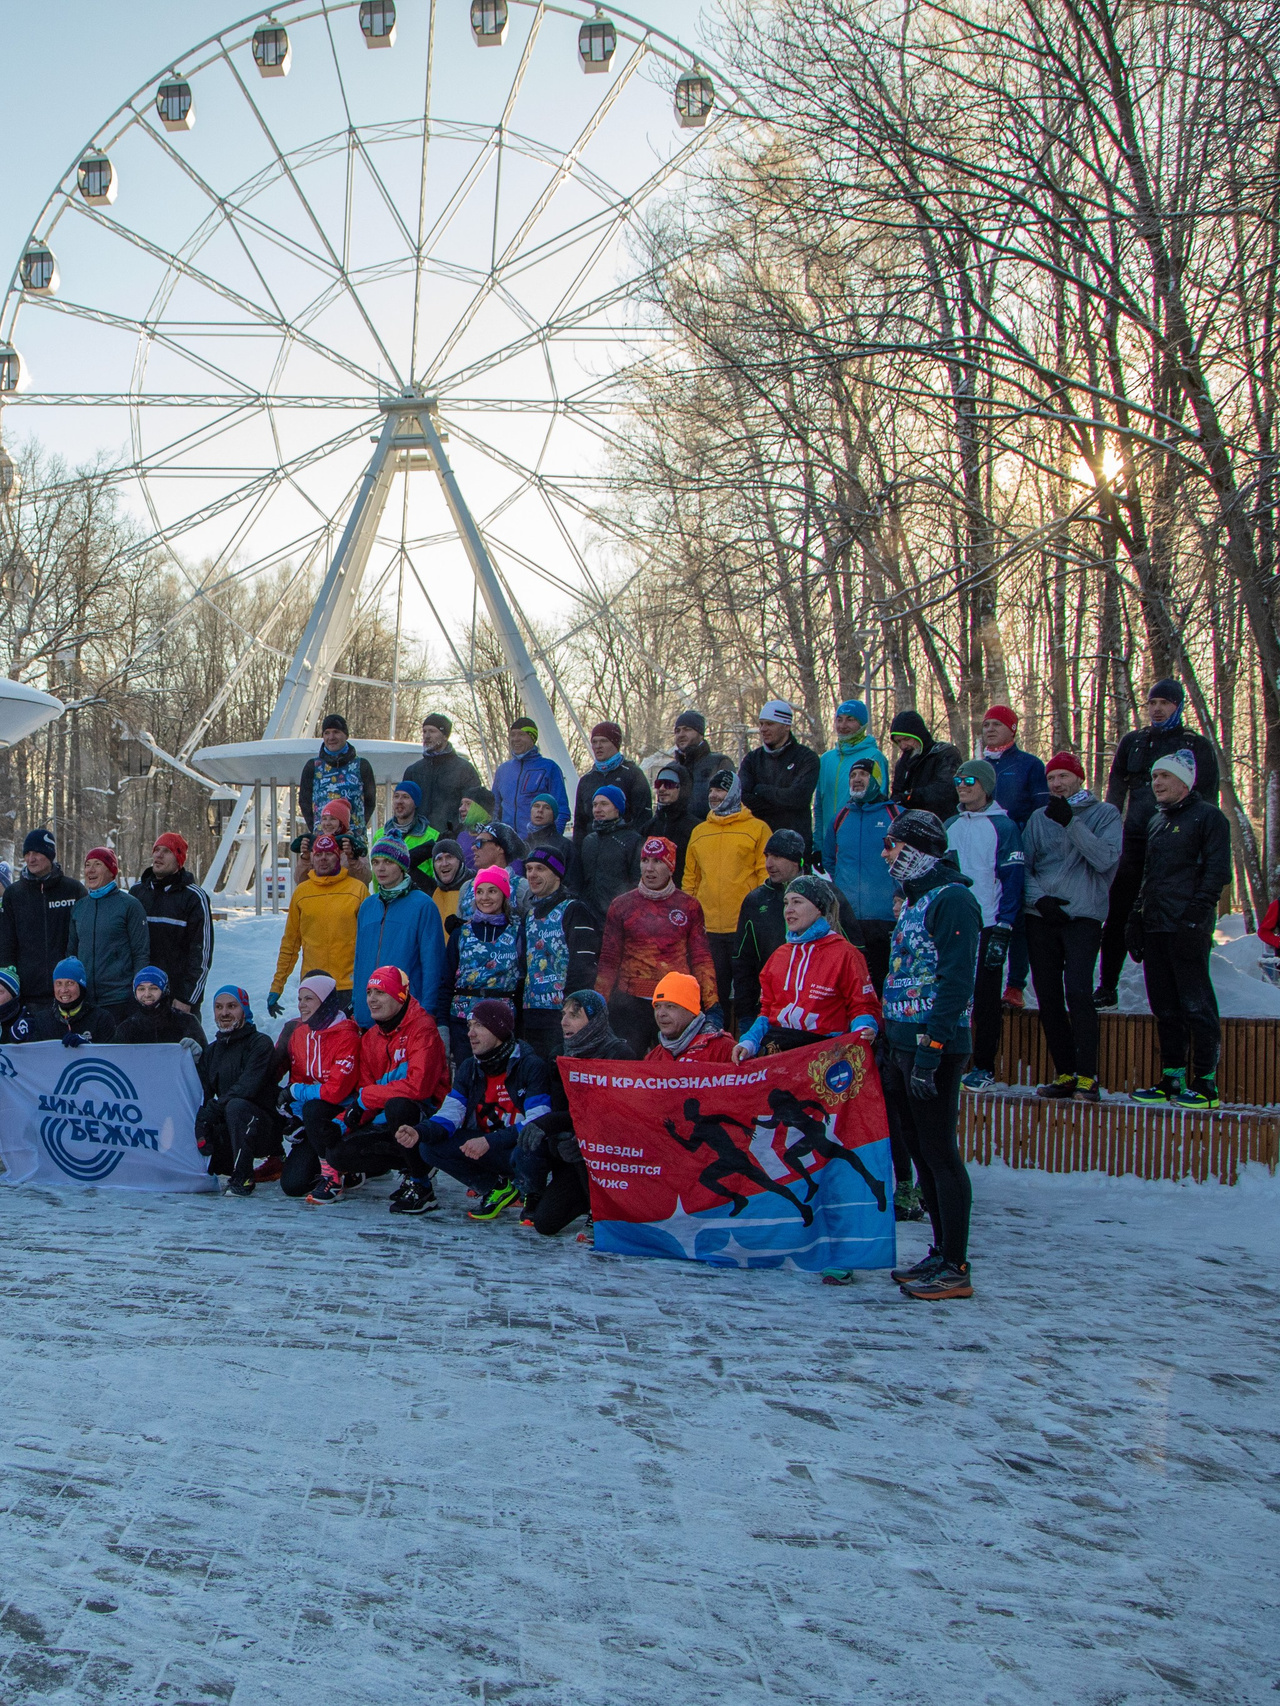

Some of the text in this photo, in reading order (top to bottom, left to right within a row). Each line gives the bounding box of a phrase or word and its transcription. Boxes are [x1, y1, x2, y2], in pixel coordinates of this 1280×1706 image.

[569, 1068, 768, 1090] БЕГИ КРАСНОЗНАМЕНСК
[38, 1094, 143, 1125] ДИНАМО
[68, 1118, 159, 1151] БЕЖИТ
[587, 1143, 644, 1158] звезды
